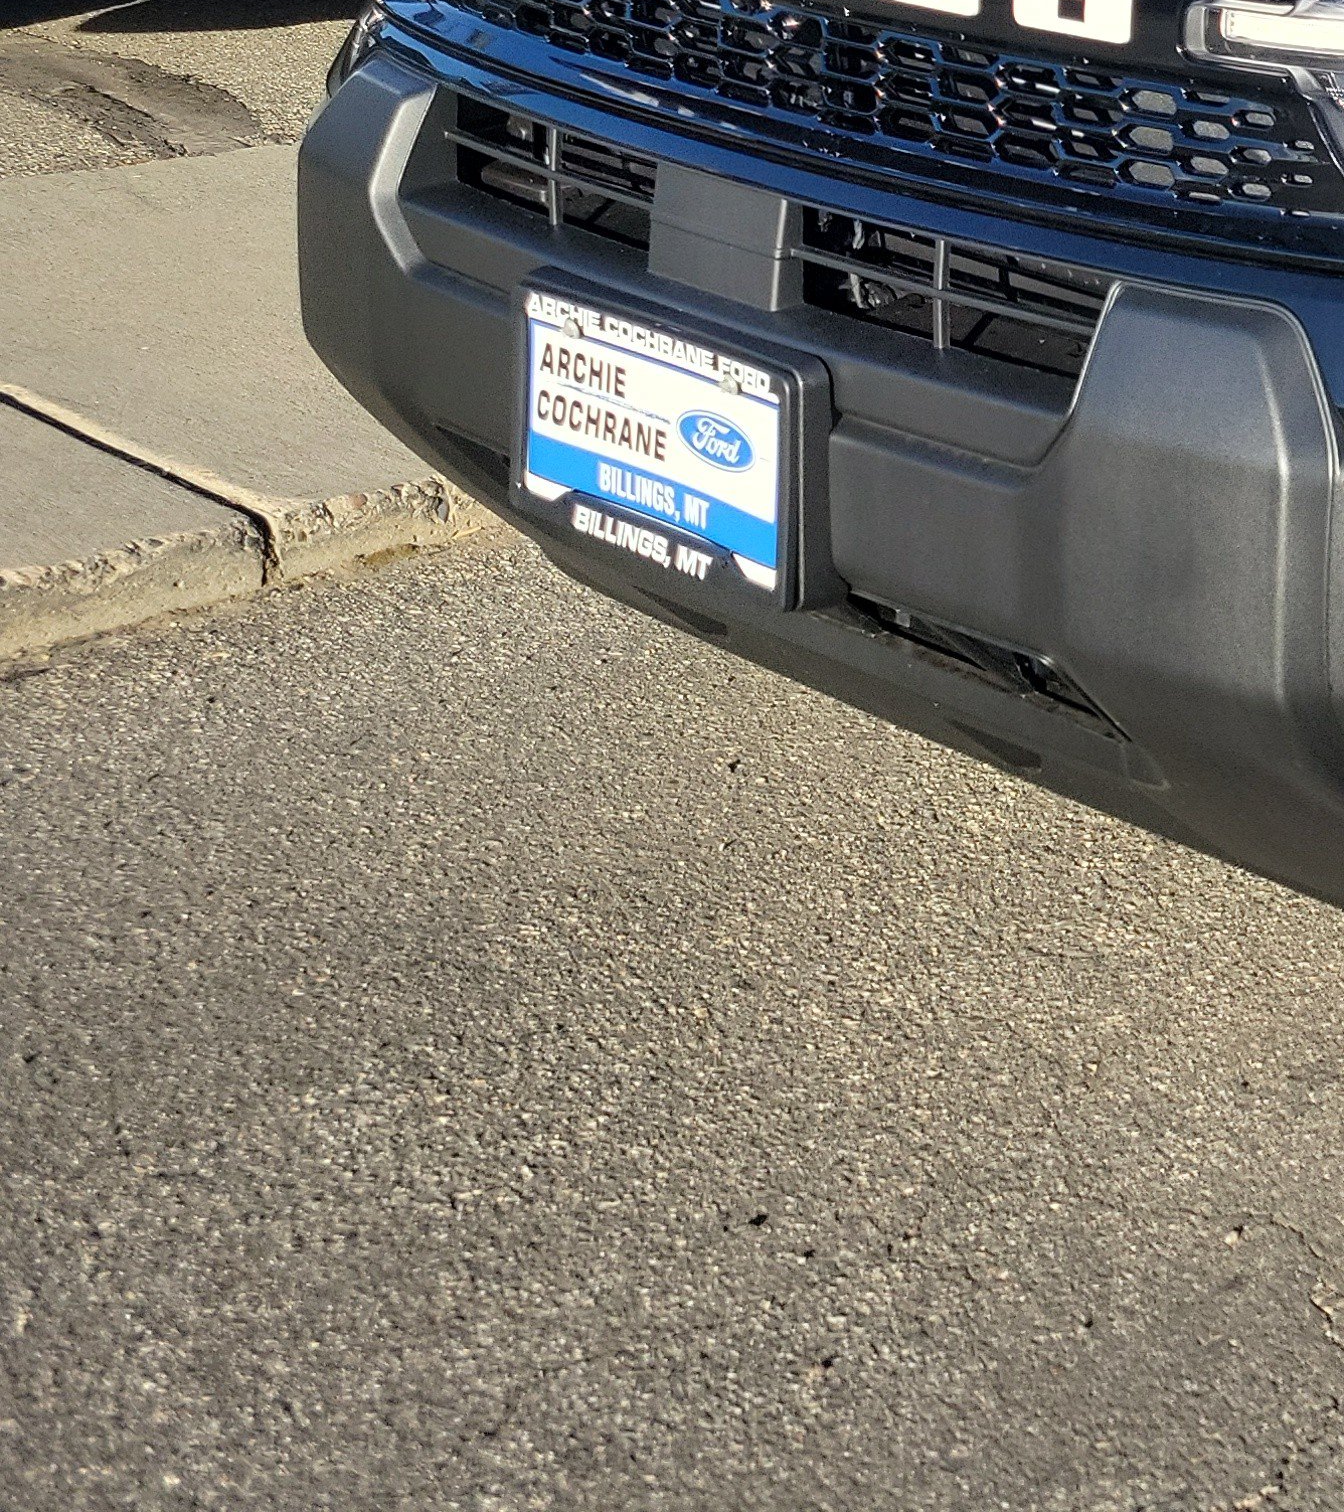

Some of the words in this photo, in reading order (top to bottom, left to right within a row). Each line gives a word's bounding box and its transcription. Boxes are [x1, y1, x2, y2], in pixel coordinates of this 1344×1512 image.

[527, 292, 601, 333] ARCHIE
[604, 317, 714, 371] COCHRANE
[717, 355, 771, 393] FORD
[539, 342, 627, 399] ARCHIE
[536, 390, 668, 463] COCHRANE
[692, 417, 740, 464] Ford
[599, 462, 681, 523] BILLINGS,
[684, 493, 711, 531] MT
[572, 503, 671, 569] BILLINGS,
[674, 543, 713, 581] MT
